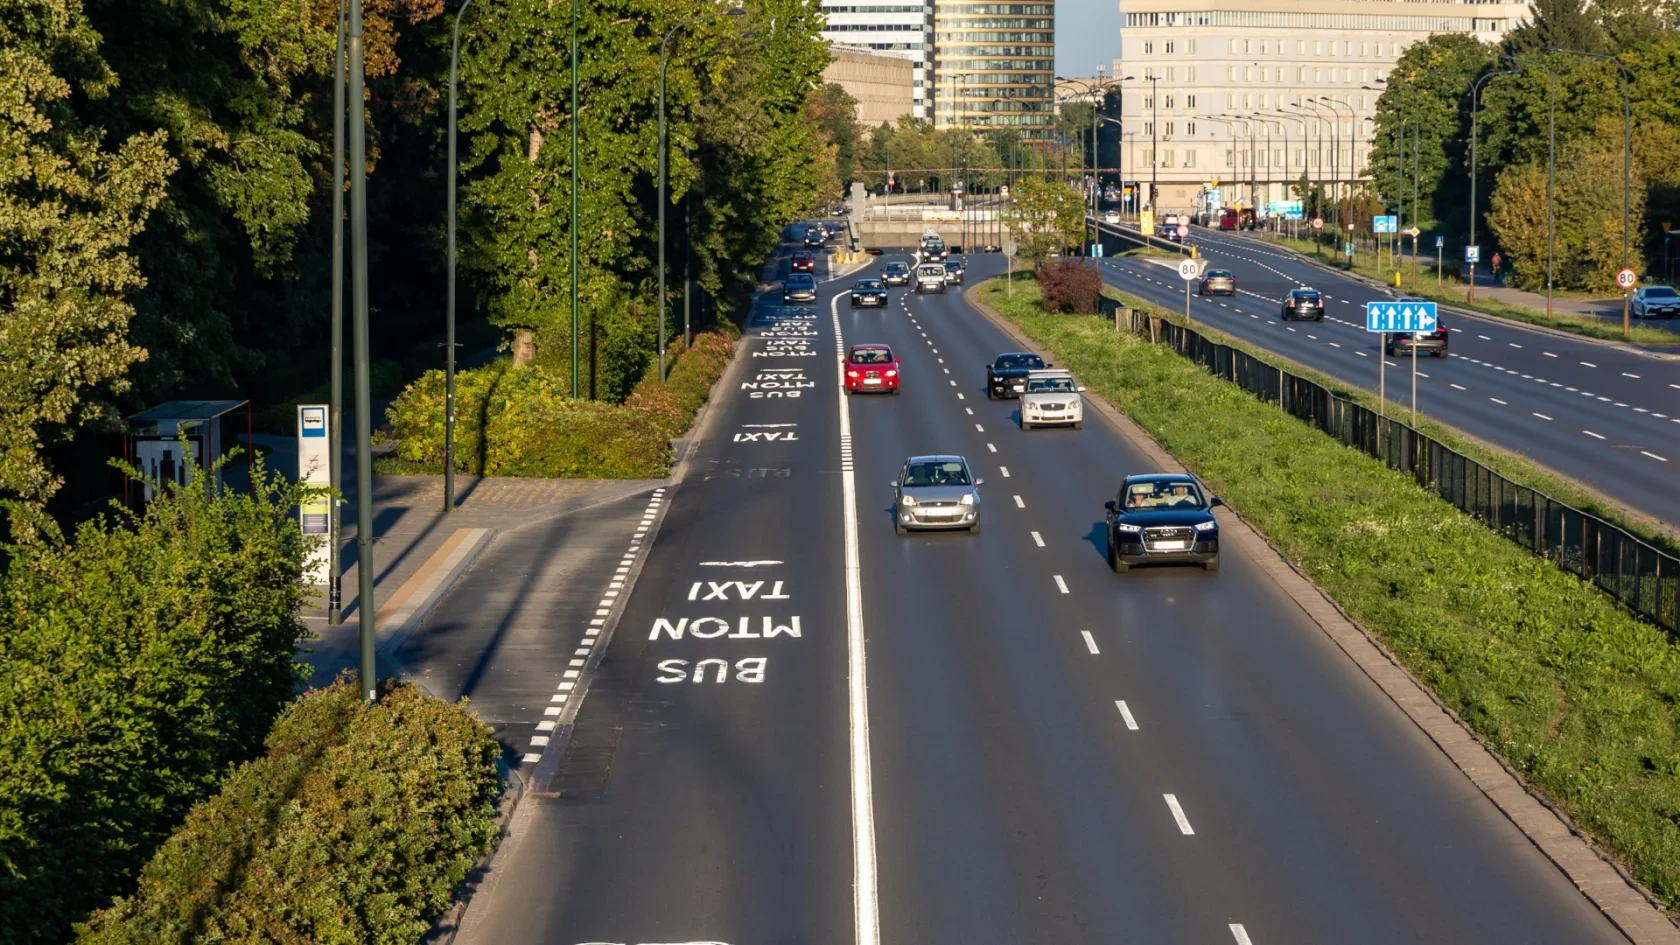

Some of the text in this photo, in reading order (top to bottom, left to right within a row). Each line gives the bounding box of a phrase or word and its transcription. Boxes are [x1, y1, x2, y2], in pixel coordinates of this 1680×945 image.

[1182, 265, 1196, 275] 80
[1620, 273, 1634, 283] 80
[741, 381, 815, 389] MTON
[750, 390, 801, 398] BUS
[733, 431, 799, 442] TAXI
[687, 580, 791, 601] TAXI
[648, 615, 802, 640] MTON
[655, 657, 768, 683] BUS
